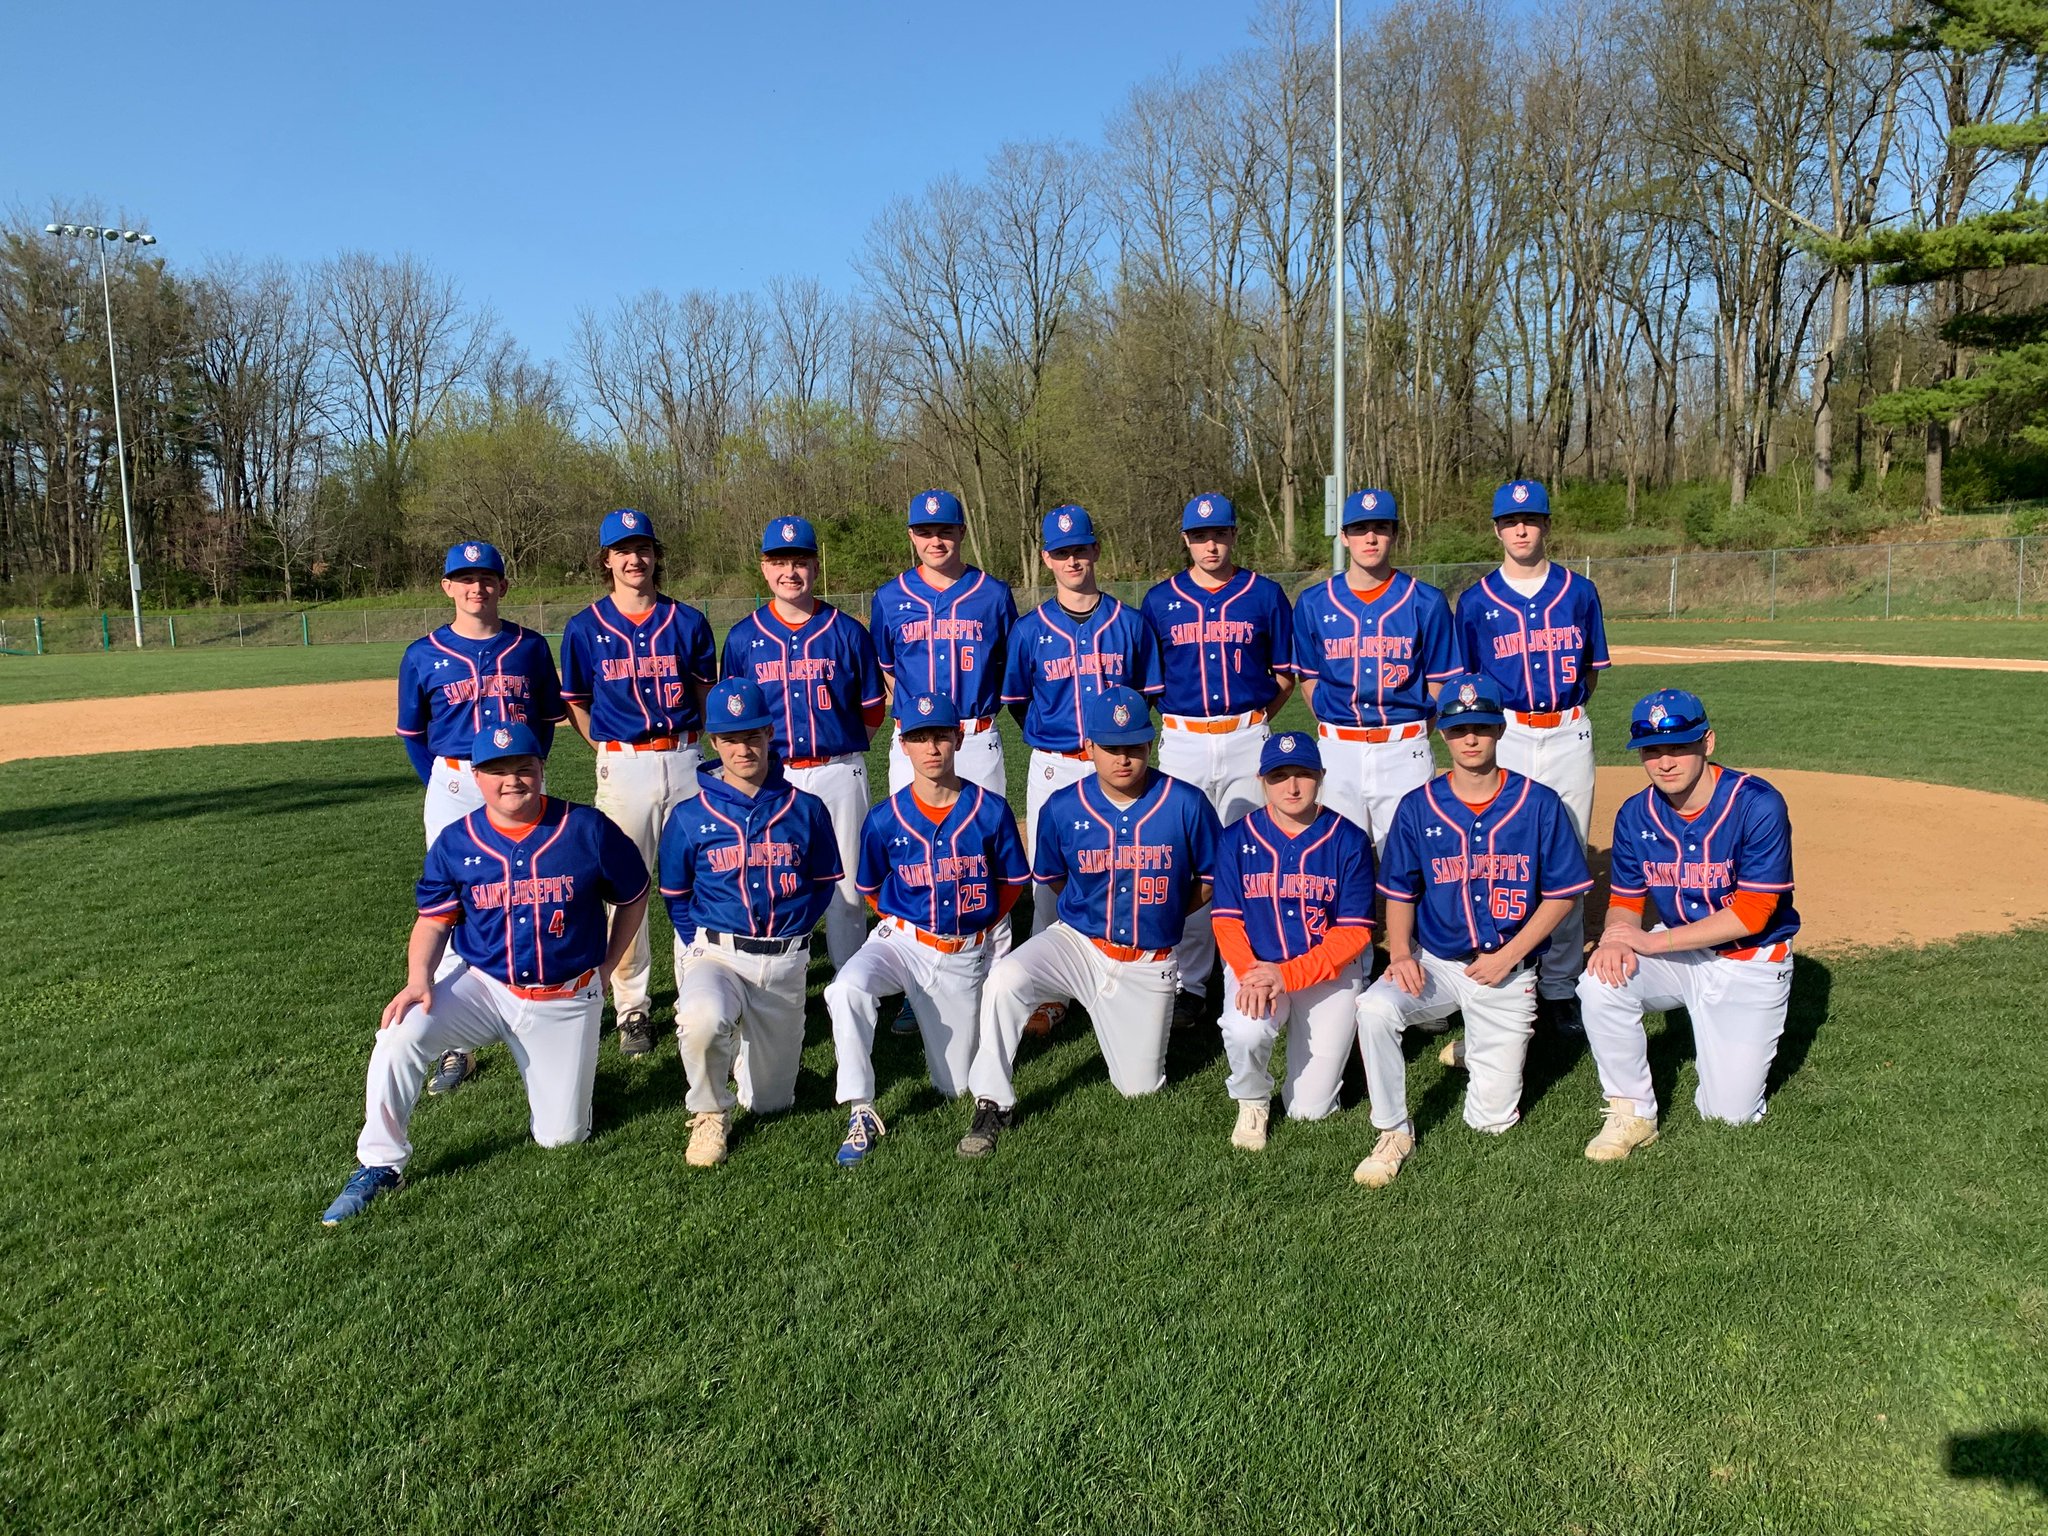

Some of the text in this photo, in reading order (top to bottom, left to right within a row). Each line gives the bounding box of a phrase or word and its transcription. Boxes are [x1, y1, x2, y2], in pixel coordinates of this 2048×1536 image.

[901, 619, 983, 643] SAINT JOSEPH'S
[1170, 621, 1254, 646] SAINT JOSEPH'S
[1493, 625, 1583, 660] SAINT JOSEPH'S
[961, 646, 974, 671] 6
[1234, 648, 1242, 674] 1
[1324, 636, 1412, 660] SAINT JOSEPH'S
[601, 657, 635, 681] SAINT
[755, 660, 786, 684] SAINT
[1043, 656, 1076, 681] SAINT
[1561, 656, 1577, 684] 5
[443, 677, 478, 705] SAINT
[664, 682, 684, 708] 12
[707, 844, 744, 873] SAINT
[898, 853, 989, 888] SAINT JOSEPH'S
[1078, 844, 1173, 873] SAINT JOSEPH'S
[1431, 853, 1530, 884] SAINT JOSEPH'S
[779, 872, 797, 898] 11
[1243, 872, 1336, 902] SAINT JOSEPH'S
[1643, 860, 1679, 887] SAINT
[471, 874, 574, 910] SAINT JOSEPH'S
[960, 883, 987, 914] 25
[1139, 876, 1169, 905] 99
[1491, 887, 1527, 920] 65
[548, 910, 565, 938] 4
